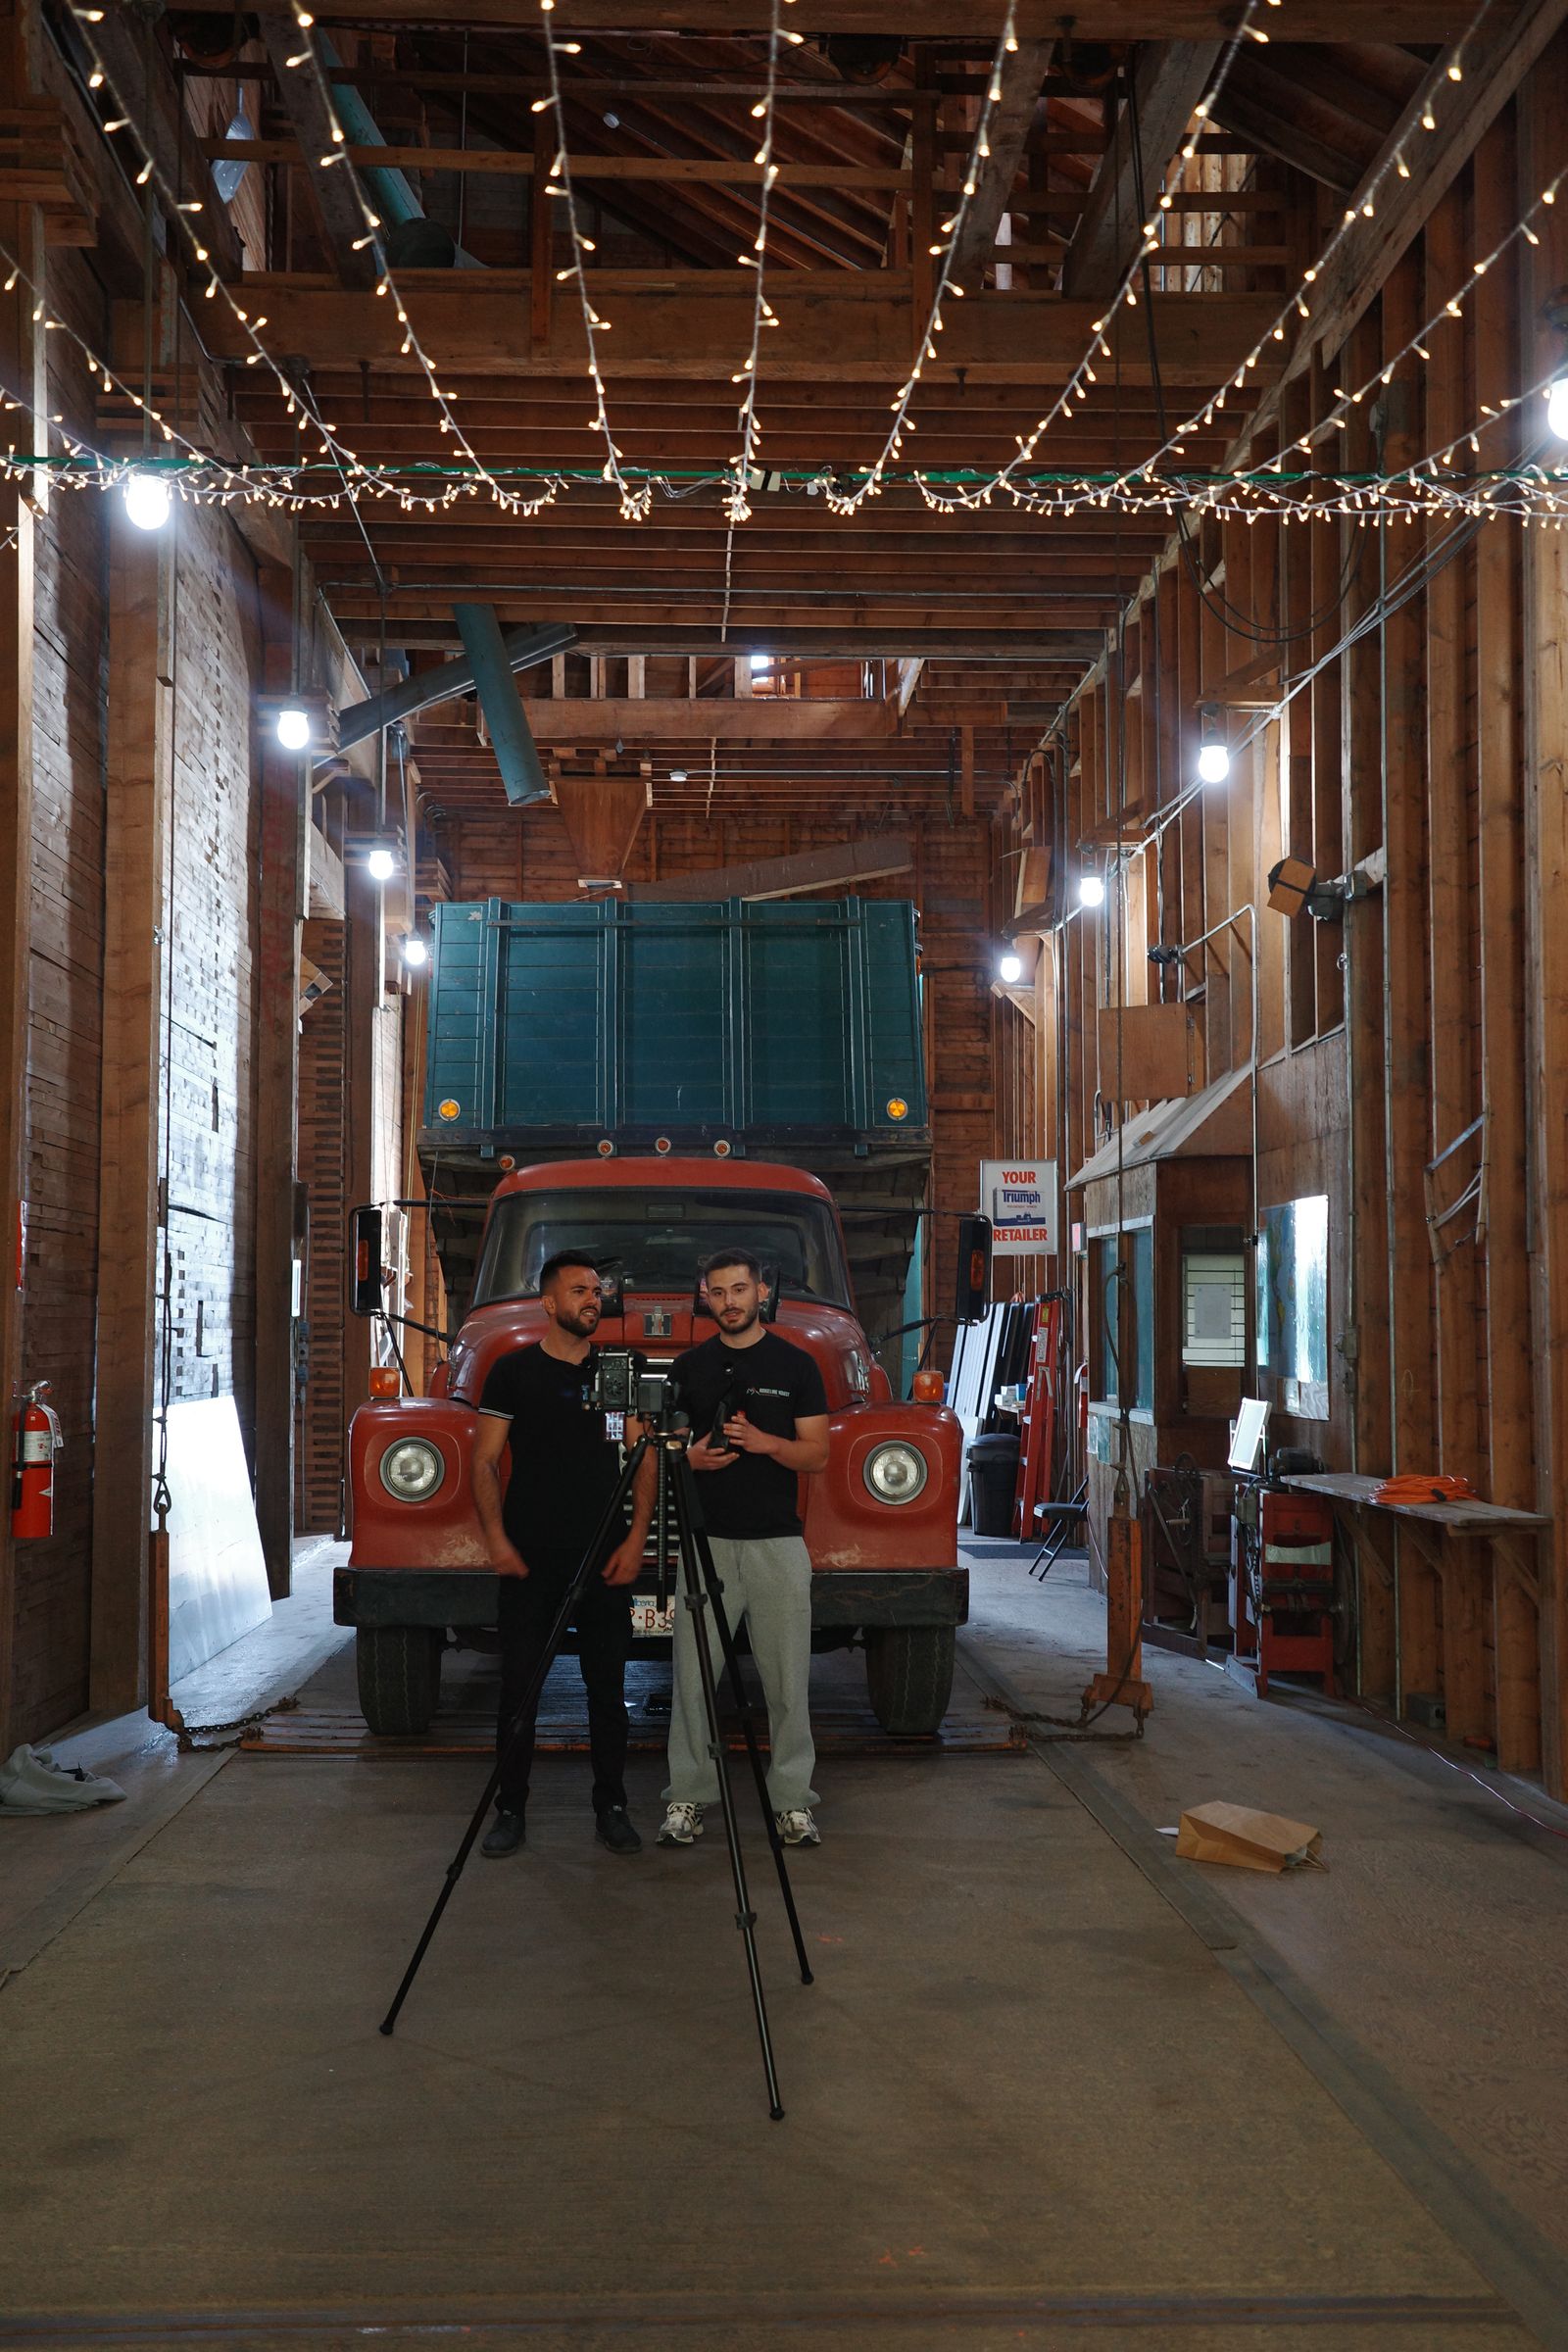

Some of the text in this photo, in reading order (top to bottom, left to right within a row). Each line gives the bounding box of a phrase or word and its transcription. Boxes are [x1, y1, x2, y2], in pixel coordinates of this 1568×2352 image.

[1002, 1171, 1037, 1184] YOUR
[1002, 1189, 1041, 1205] Triumph
[993, 1228, 1048, 1242] RETAILER
